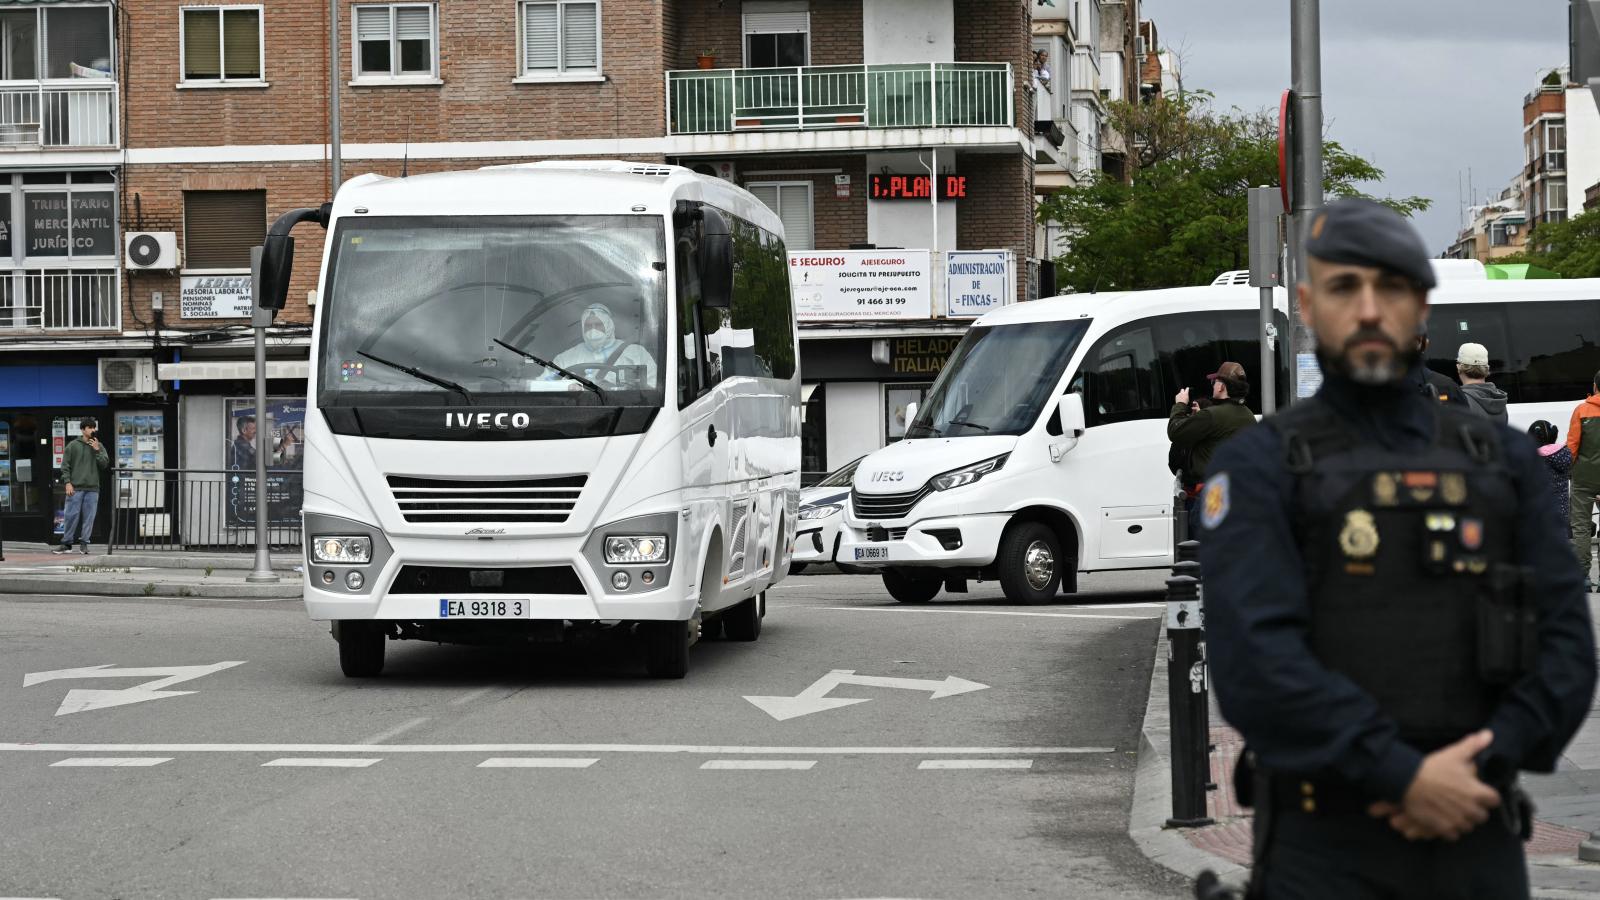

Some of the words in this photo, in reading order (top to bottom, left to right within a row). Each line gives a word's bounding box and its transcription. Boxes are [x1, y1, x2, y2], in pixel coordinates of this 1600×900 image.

[947, 176, 965, 197] DE
[32, 198, 110, 210] TRIBUTARIO
[34, 218, 110, 229] MERCANTIL
[32, 235, 94, 250] JURÍDICO
[788, 258, 797, 266] E
[800, 257, 845, 266] SEGUROS
[861, 258, 905, 266] AJESEGUROS
[948, 262, 1004, 274] ADMINISTRACION
[972, 280, 981, 289] DE
[962, 294, 991, 306] FINCAS
[446, 413, 530, 429] IVECO
[871, 472, 904, 481] IVECO
[858, 548, 864, 557] EA
[865, 548, 880, 557] 0669
[881, 548, 888, 557] 31
[448, 601, 465, 615] EA
[471, 601, 506, 616] 9318
[514, 601, 522, 616] 3
